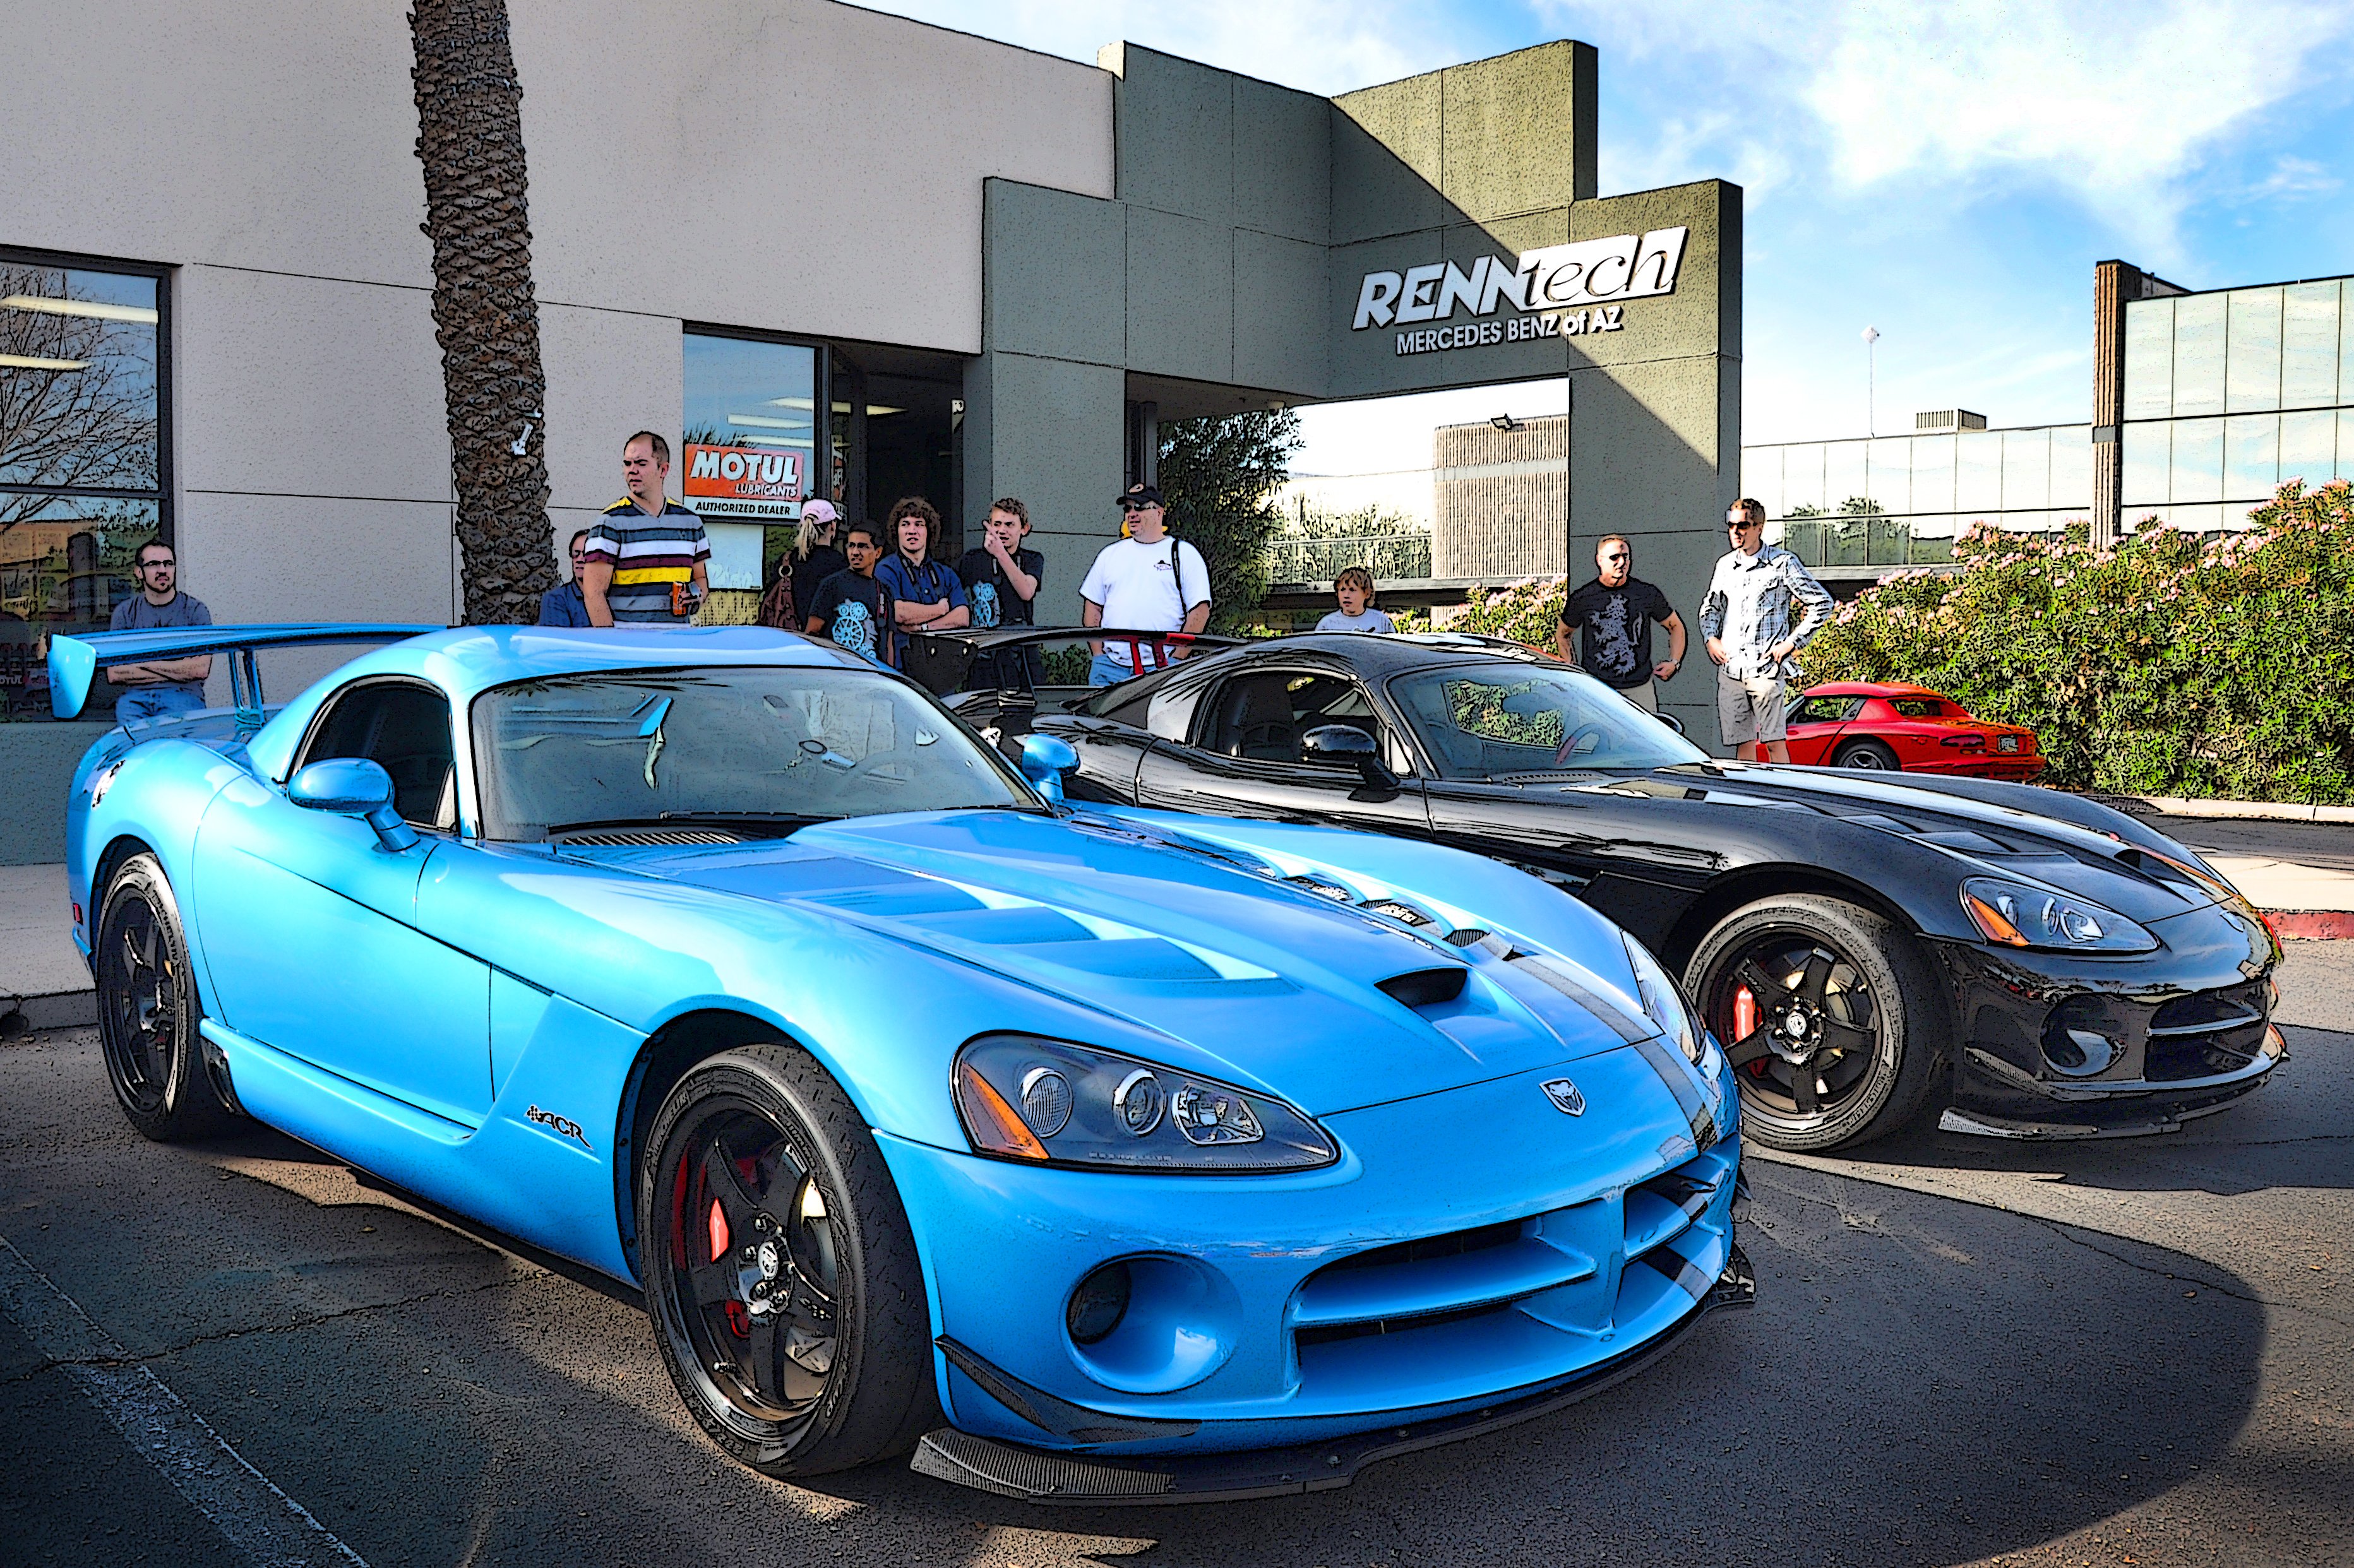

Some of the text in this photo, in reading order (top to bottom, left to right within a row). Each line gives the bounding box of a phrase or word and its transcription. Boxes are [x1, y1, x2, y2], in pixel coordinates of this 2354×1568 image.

[1395, 306, 1623, 355] MERCEDES BENZ of AZ
[690, 449, 798, 485] MOTUL
[695, 501, 791, 515] AUTHORIZED DEALER
[735, 483, 798, 497] LUBRICANTS
[537, 1111, 594, 1148] ACR
